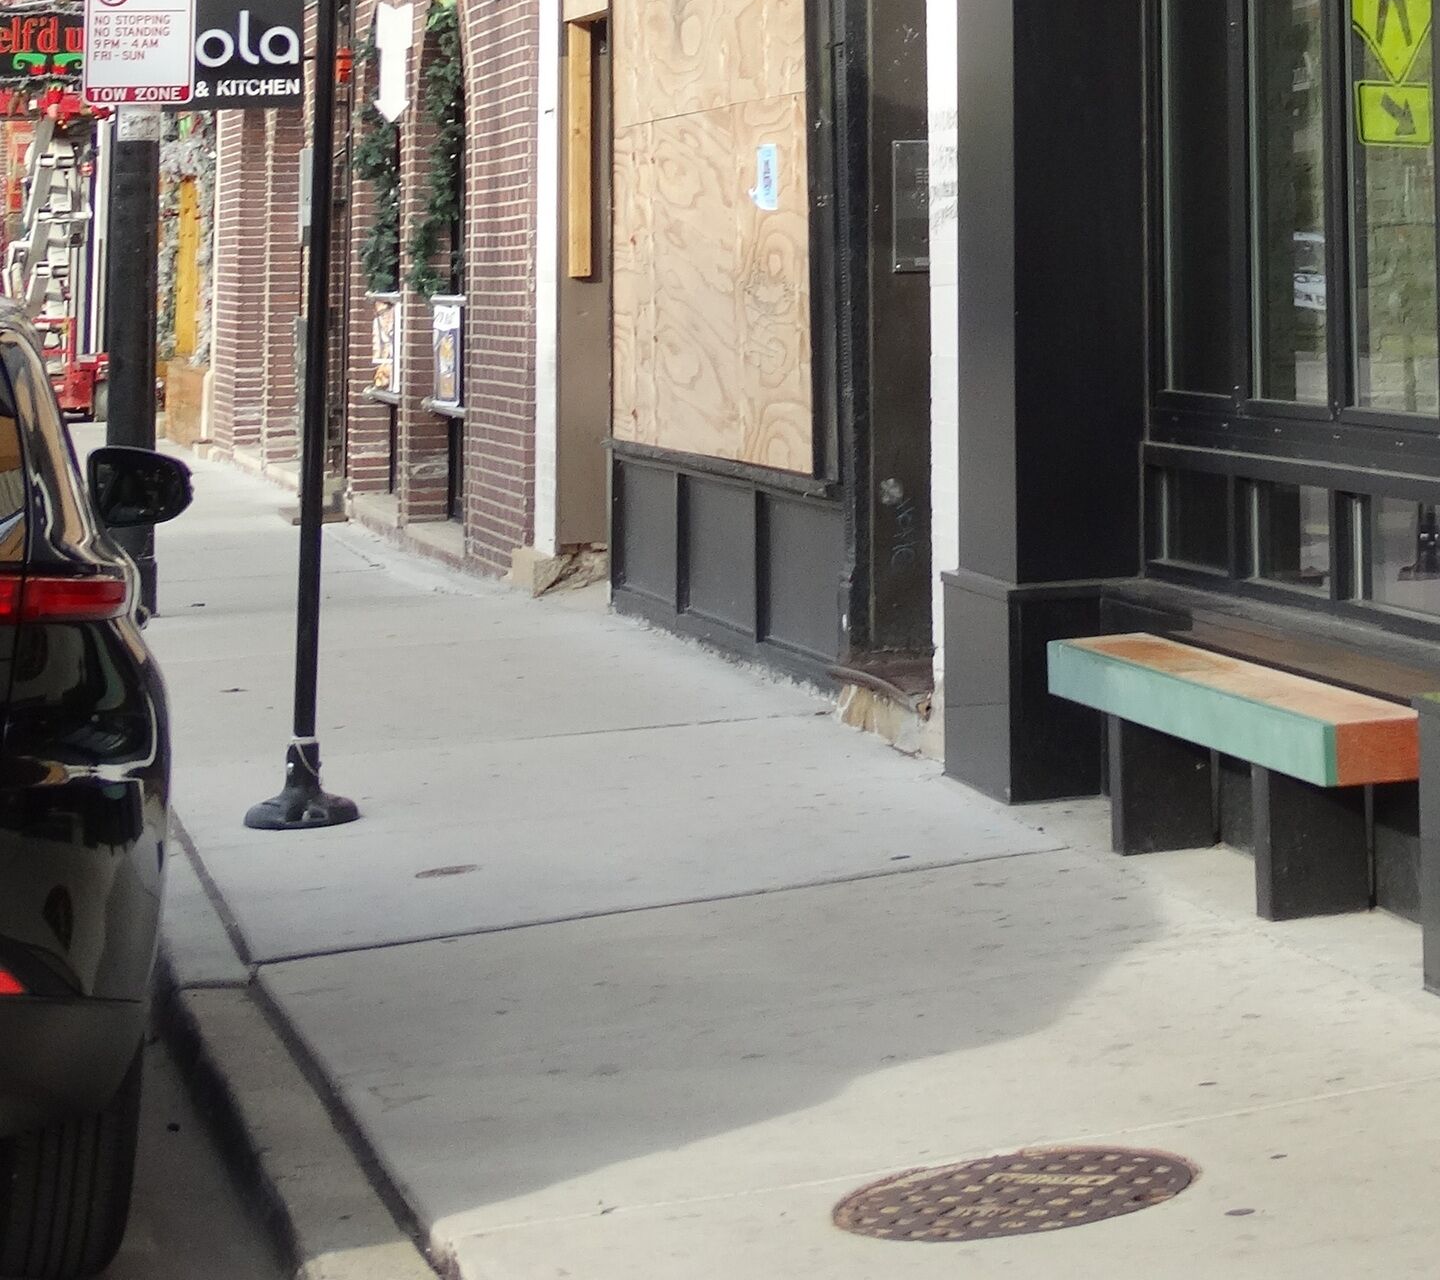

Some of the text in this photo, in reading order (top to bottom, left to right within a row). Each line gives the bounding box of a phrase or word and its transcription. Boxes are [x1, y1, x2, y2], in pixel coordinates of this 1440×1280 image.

[94, 15, 171, 26] NO STOPPING
[94, 27, 171, 37] NO STANDING
[94, 39, 101, 49] 9
[103, 39, 120, 48] PM
[131, 39, 138, 48] 4
[141, 38, 159, 48] AM
[93, 50, 112, 60] FRI
[122, 50, 145, 60] SUN
[194, 78, 300, 97] & KITCHEN
[91, 88, 182, 101] TOW ZONE
